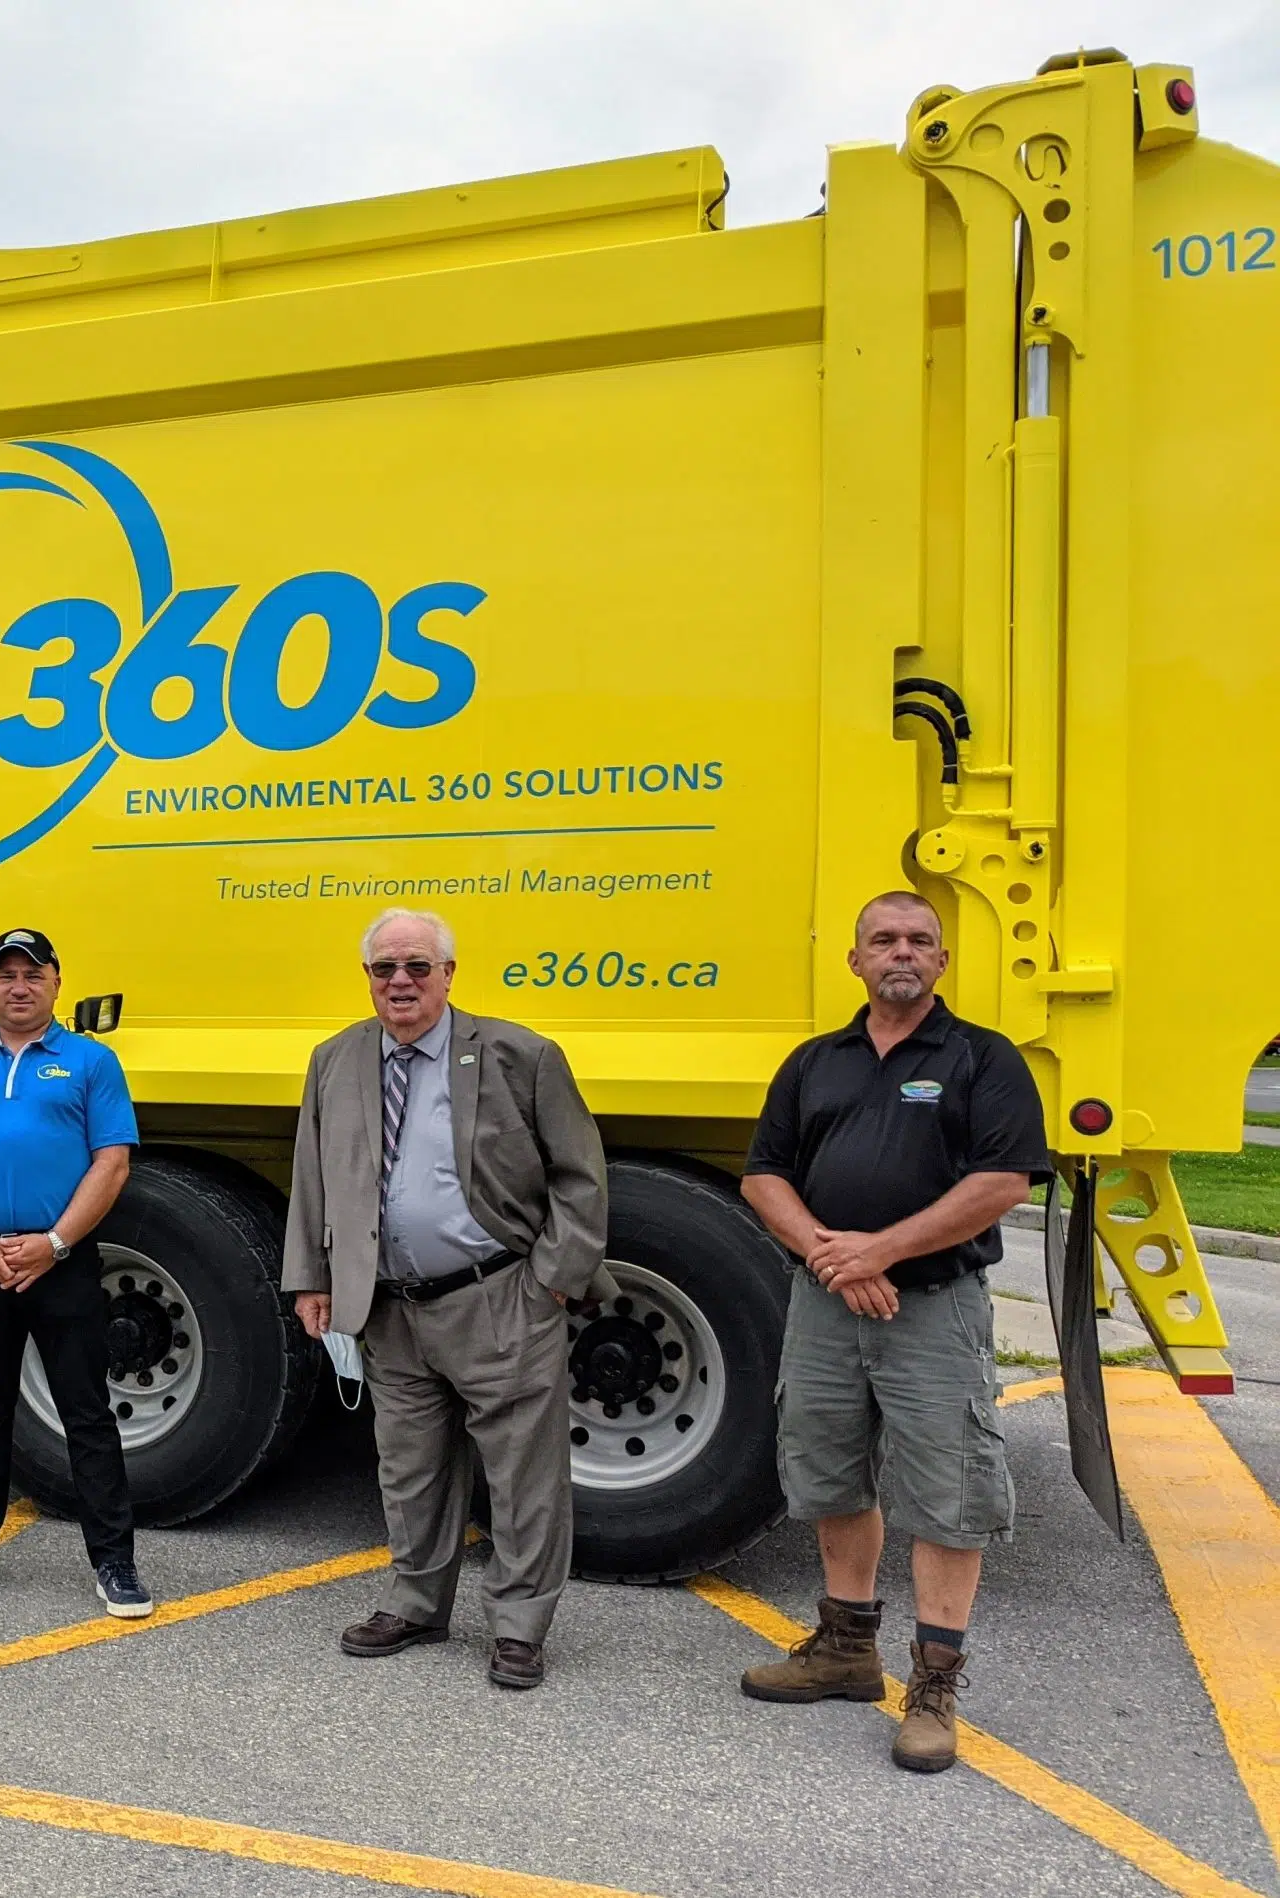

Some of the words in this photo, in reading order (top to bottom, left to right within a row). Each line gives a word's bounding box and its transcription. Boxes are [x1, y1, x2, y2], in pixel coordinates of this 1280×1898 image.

[1151, 226, 1277, 279] 1012
[125, 776, 417, 815] ENVIRONMENTAL
[426, 772, 491, 802] 360
[504, 761, 724, 798] SOLUTIONS
[216, 874, 311, 900] Trusted
[319, 868, 511, 898] Environmental
[520, 868, 713, 899] Management
[502, 951, 720, 988] e360s.ca
